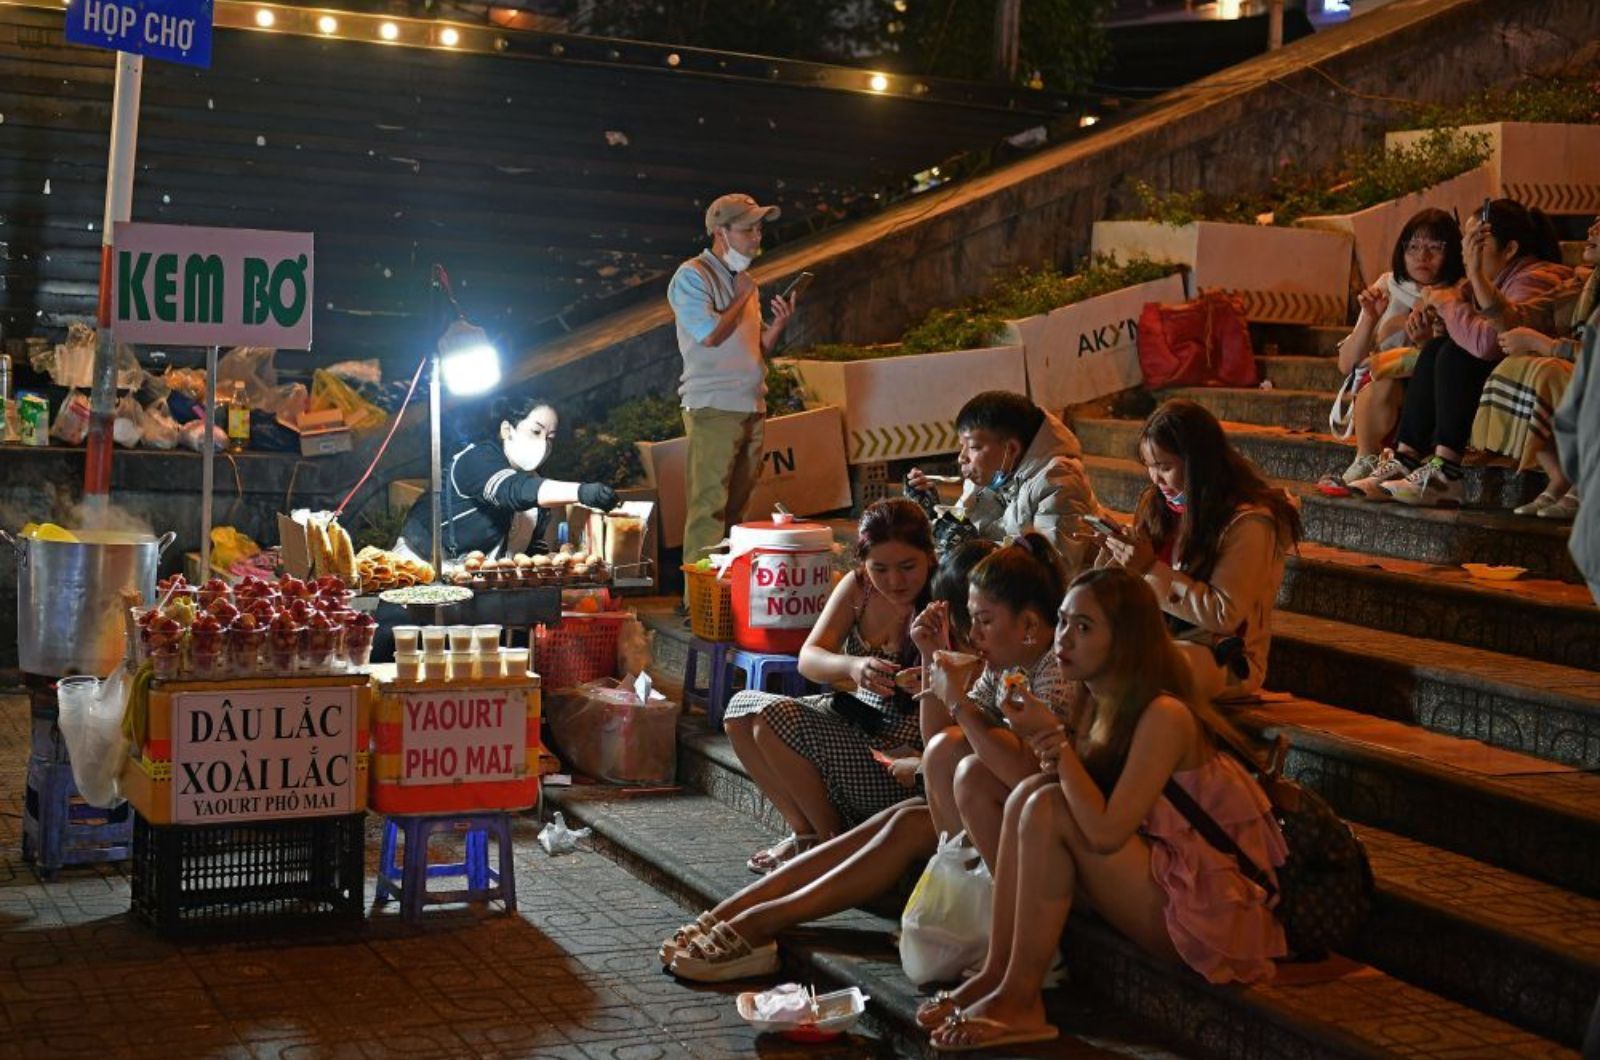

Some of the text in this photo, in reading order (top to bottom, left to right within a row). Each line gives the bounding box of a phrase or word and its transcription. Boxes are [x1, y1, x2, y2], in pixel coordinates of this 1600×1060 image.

[144, 12, 196, 57] CHỢ
[117, 251, 309, 328] KEM BƠ
[756, 561, 807, 592] ĐẬU
[766, 590, 825, 616] NÓNG
[189, 695, 342, 744] DÂU LẮC
[406, 697, 507, 731] YAOURT
[179, 746, 349, 794] XOÀI LẮC
[406, 743, 513, 779] PHO MAI
[193, 790, 336, 817] YAOURT PHÔ MAI
